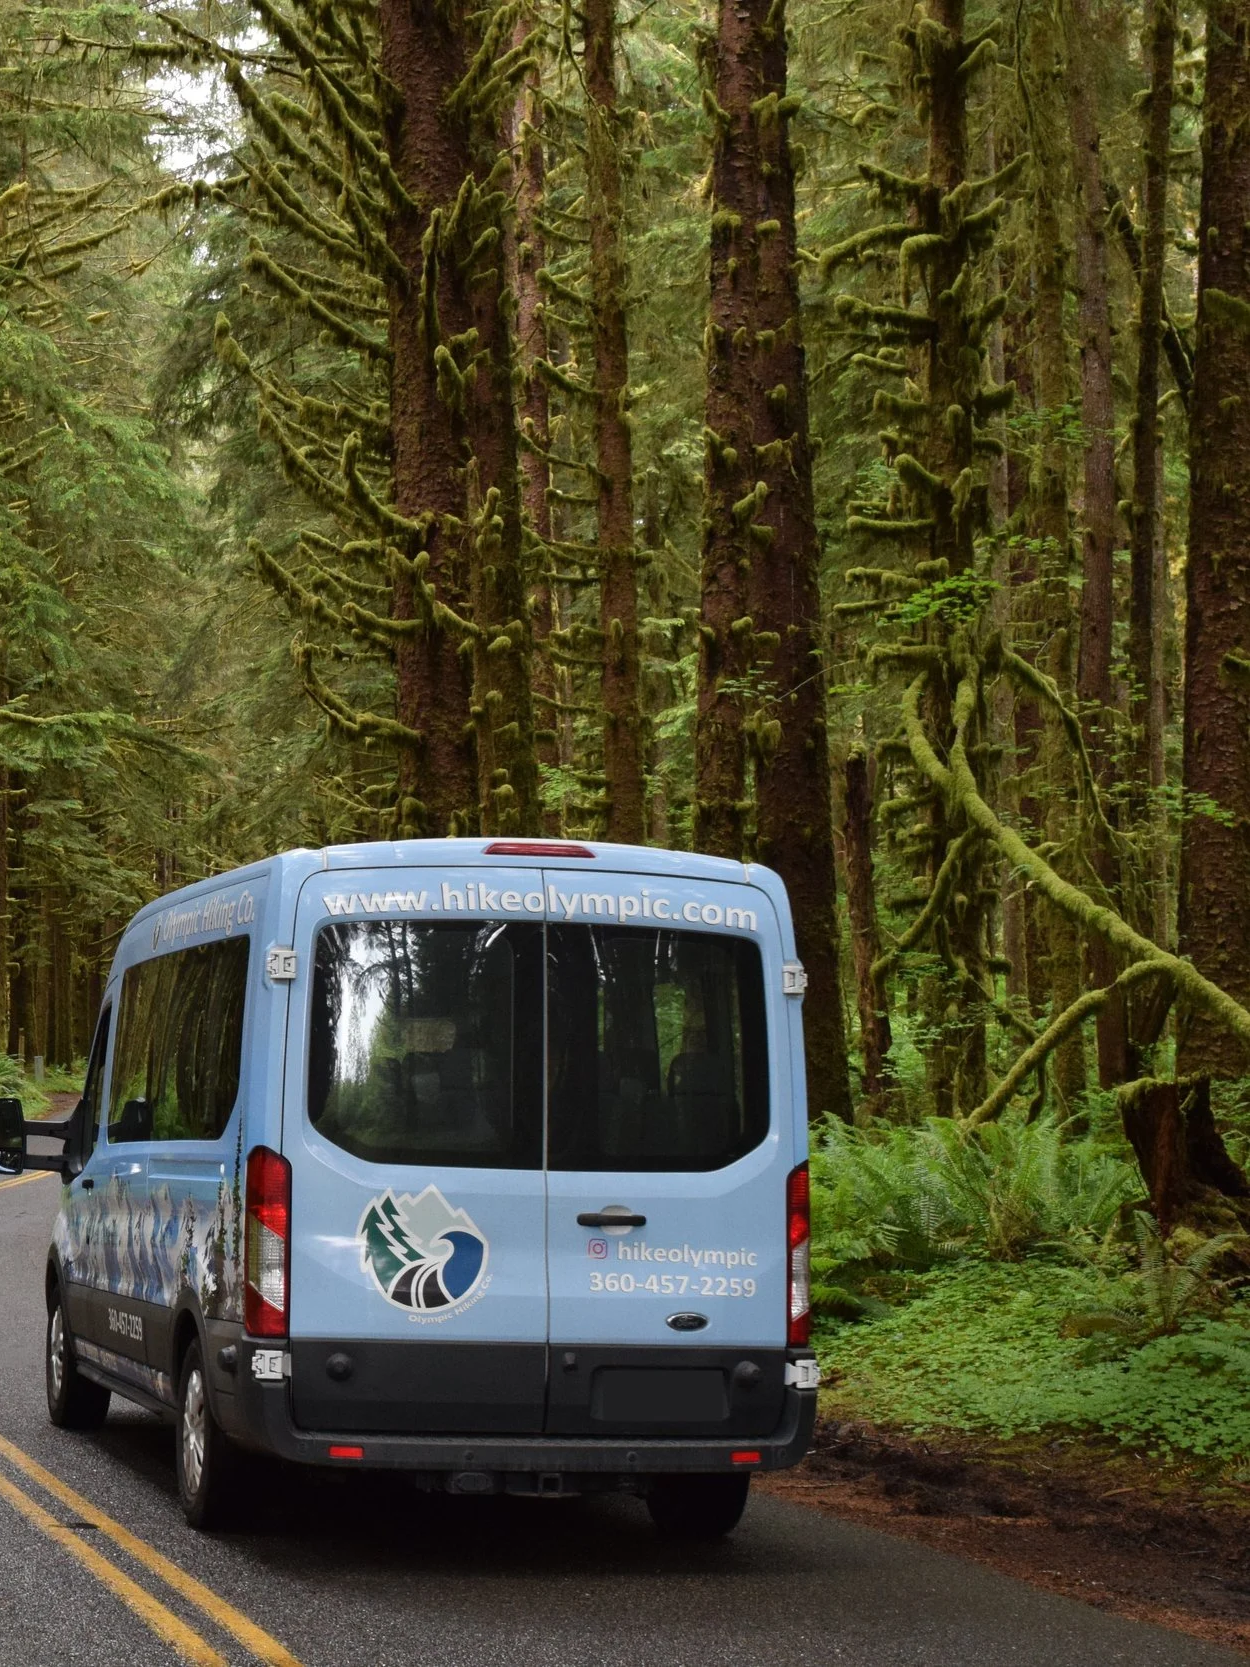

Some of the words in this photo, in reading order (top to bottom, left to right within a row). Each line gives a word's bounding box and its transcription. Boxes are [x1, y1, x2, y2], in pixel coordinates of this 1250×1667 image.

[201, 895, 236, 936] Hiking
[323, 882, 758, 931] www.hikeolympic.com
[617, 1241, 758, 1269] hikeolympic
[589, 1271, 757, 1298] 360-457-2259
[408, 1313, 453, 1324] Olympic
[454, 1290, 486, 1315] Hiking
